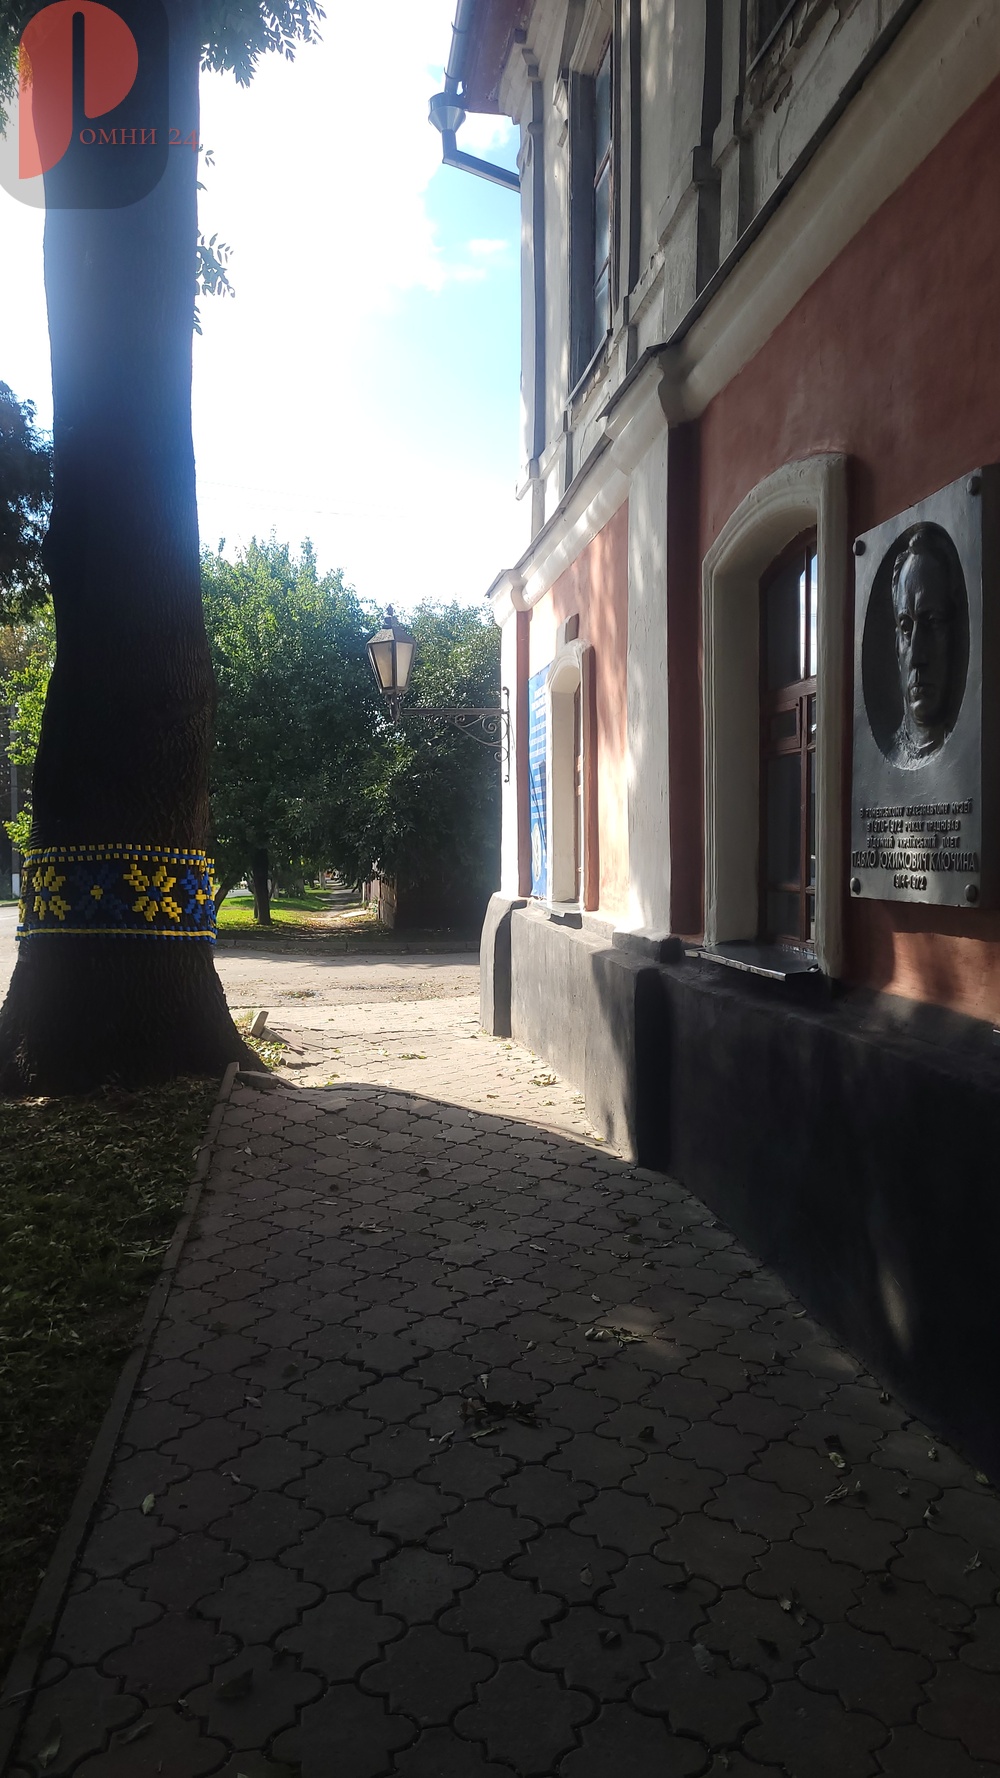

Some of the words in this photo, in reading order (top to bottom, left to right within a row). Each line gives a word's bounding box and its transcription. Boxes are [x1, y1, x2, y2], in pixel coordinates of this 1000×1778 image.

[926, 820, 961, 833] ПРАЦЮВАВ
[941, 836, 960, 848] ПОЕТ
[852, 850, 878, 868] ПАВЛО
[880, 850, 929, 871] ЮХИМОВИЧ
[930, 851, 976, 872] КЛЮЧИНА
